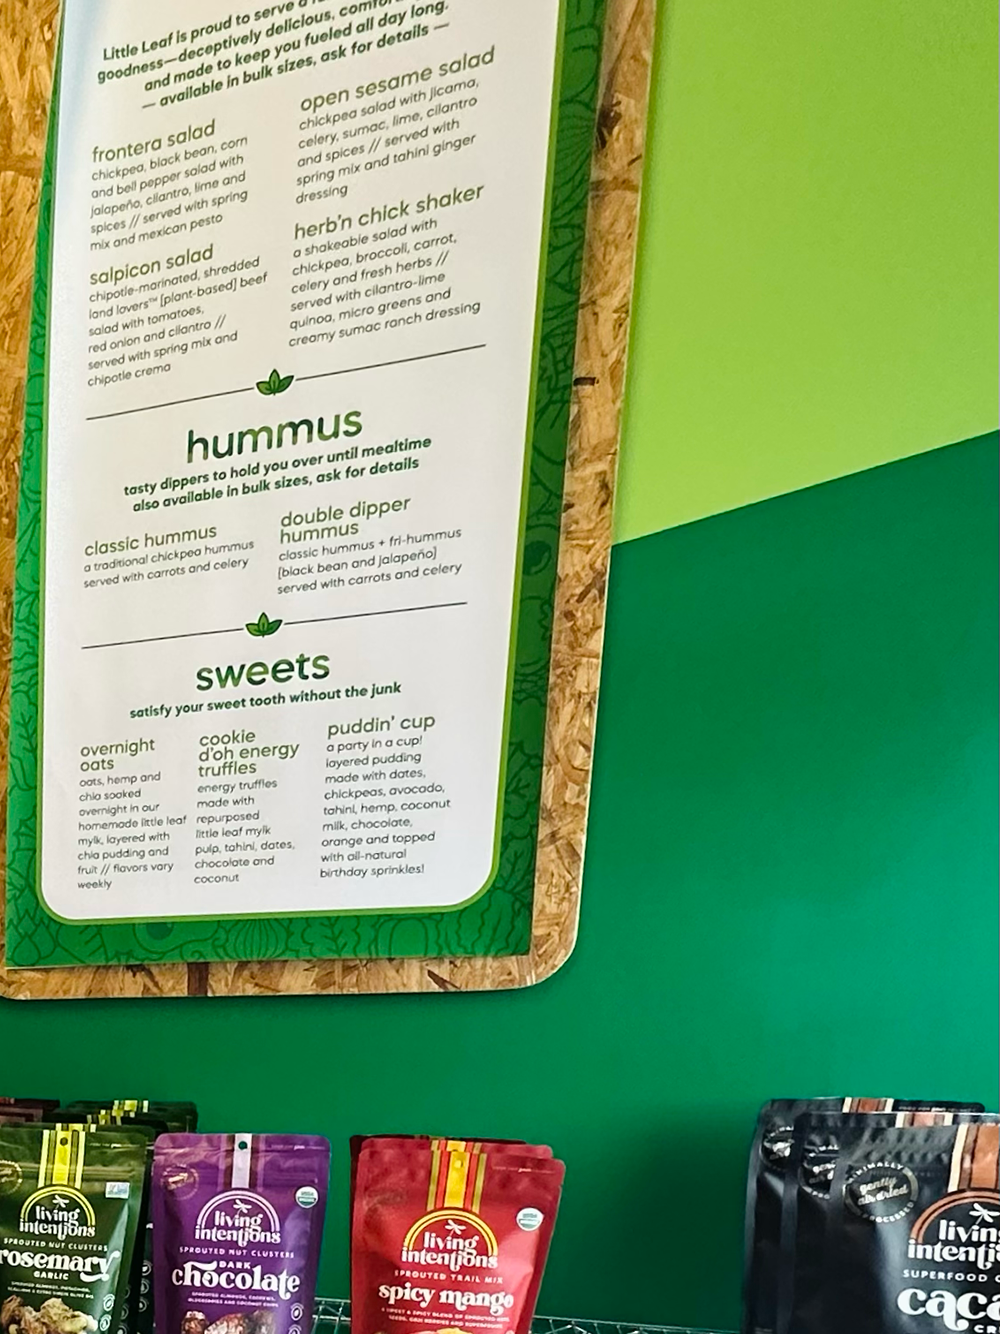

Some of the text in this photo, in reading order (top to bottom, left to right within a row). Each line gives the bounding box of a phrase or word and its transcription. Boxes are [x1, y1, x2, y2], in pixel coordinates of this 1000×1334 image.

[144, 0, 449, 92] and made to keep you fueled all day long.
[300, 44, 496, 114] open sesame salad
[92, 117, 216, 163] frontera salad
[357, 199, 410, 227] chick
[415, 184, 485, 214] shaker
[89, 242, 214, 287] salpicon salad
[288, 301, 481, 348] creamy sumac ranch dressing
[186, 410, 363, 464] hummus
[123, 437, 432, 497] tasty dippers to hold you over until mealtime
[280, 497, 412, 528] double dipper
[84, 526, 218, 557] classic hummus
[279, 522, 360, 545] hummus
[196, 652, 330, 692] sweets
[129, 681, 402, 719] satisfy your sweet tooth without the junk
[399, 715, 436, 733] cup
[79, 737, 156, 758] overnight
[198, 728, 256, 748] cookie
[238, 743, 300, 761] energy
[79, 758, 115, 773] oats
[197, 760, 257, 778] truffles
[319, 863, 425, 879] birthday sprinkles!
[35, 1206, 80, 1224] living
[214, 1211, 263, 1227] living
[19, 1220, 96, 1240] intentions
[195, 1225, 281, 1247] intentions
[423, 1231, 479, 1254] living
[219, 1261, 251, 1270] DARK
[401, 1248, 498, 1272] intentions
[34, 1270, 69, 1280] GARLIC
[171, 1261, 300, 1300] chocolate
[450, 1273, 481, 1283] TRAIL
[485, 1276, 503, 1284] MIX
[902, 1269, 988, 1282] SUPERFOOD
[378, 1282, 514, 1315] spicy mango
